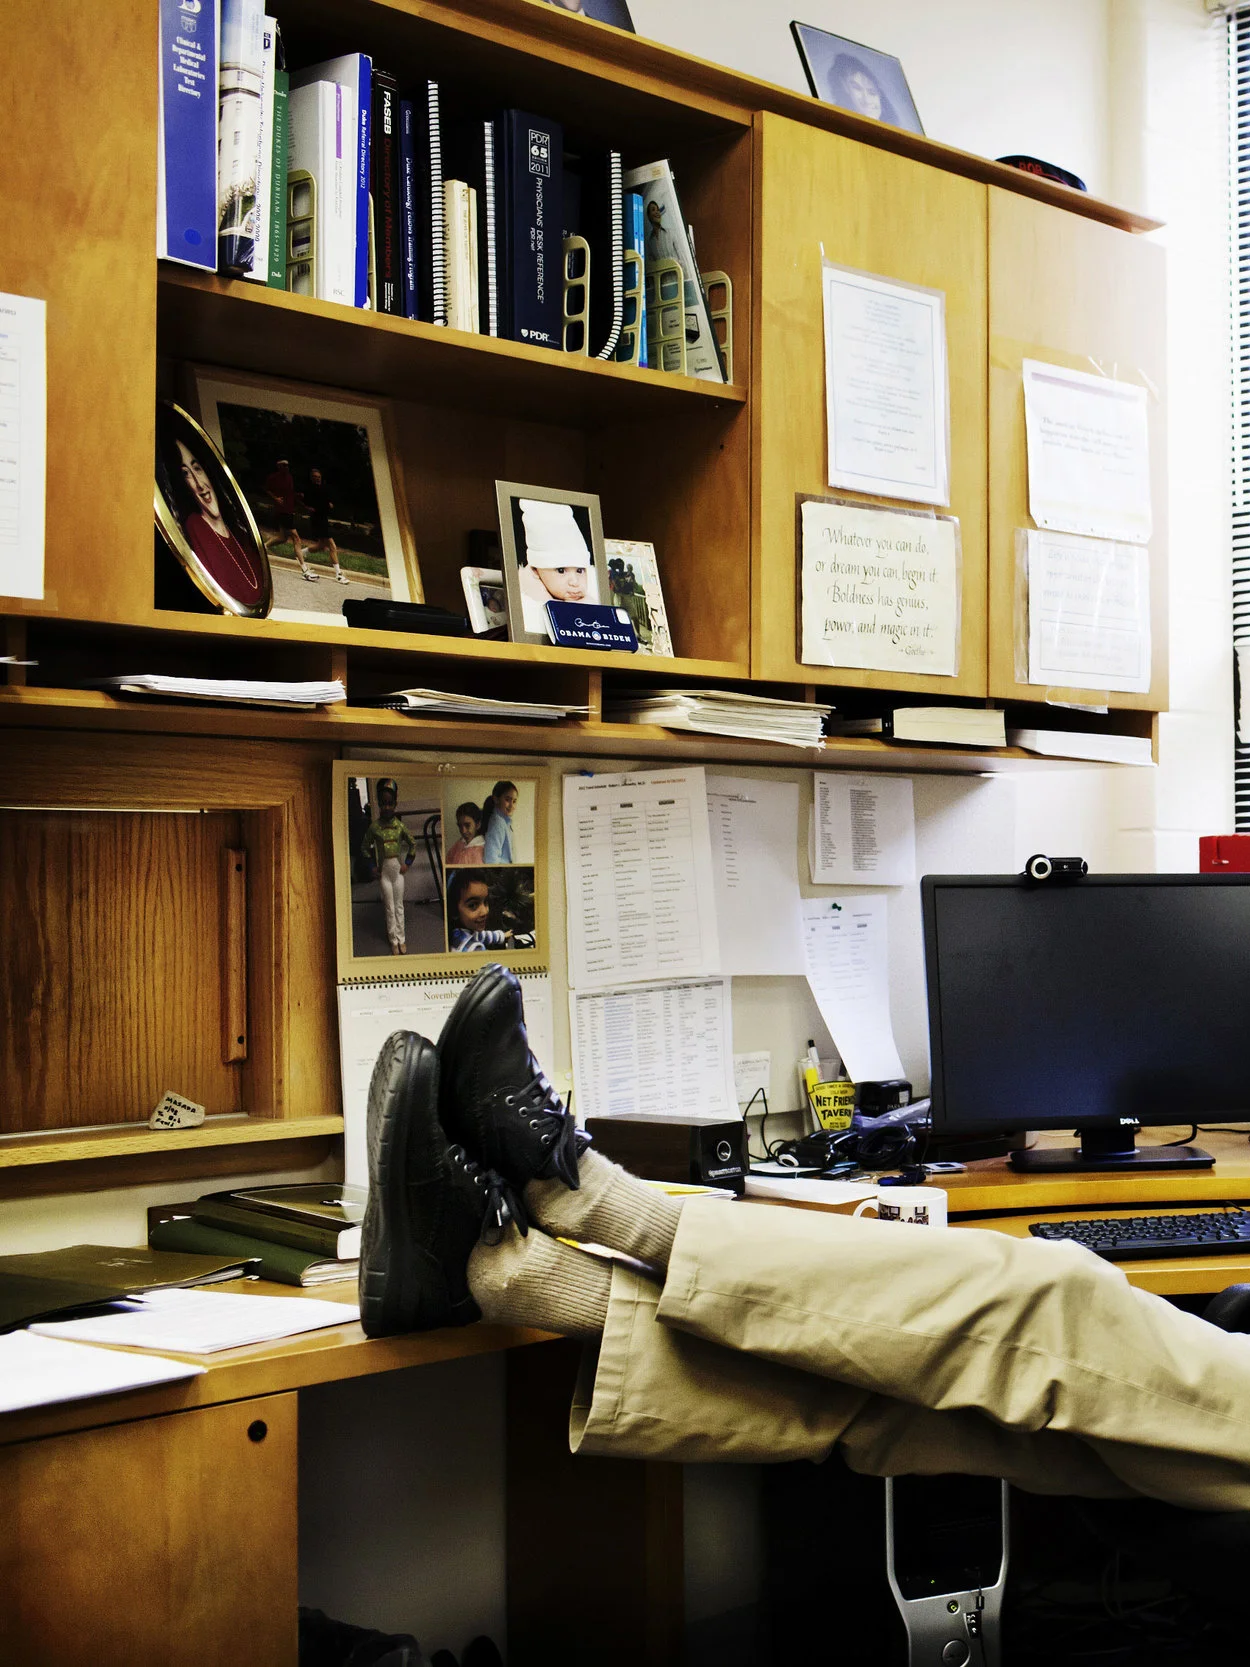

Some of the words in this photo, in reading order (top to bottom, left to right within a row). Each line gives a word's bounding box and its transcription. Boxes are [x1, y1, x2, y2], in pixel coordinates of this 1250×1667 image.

[180, 56, 199, 68] Medical
[384, 91, 392, 134] FASEB
[530, 132, 548, 145] PDR
[530, 145, 548, 158] 65
[530, 162, 548, 174] 2011
[536, 230, 544, 251] DESK
[530, 330, 549, 342] PDR
[822, 525, 872, 548] Whatever
[876, 537, 893, 558] you
[896, 541, 912, 552] can
[815, 560, 826, 572] or
[830, 553, 860, 576] dream
[861, 565, 880, 585] you
[902, 560, 926, 590] begin
[827, 580, 874, 605] Boldness
[878, 587, 893, 606] has
[858, 614, 876, 634] and
[880, 620, 908, 644] magic
[910, 625, 919, 637] in
[560, 630, 591, 638] OBAMA
[602, 634, 631, 642] BIDEN
[816, 1095, 832, 1107] NET
[821, 1108, 852, 1120] TAVERN
